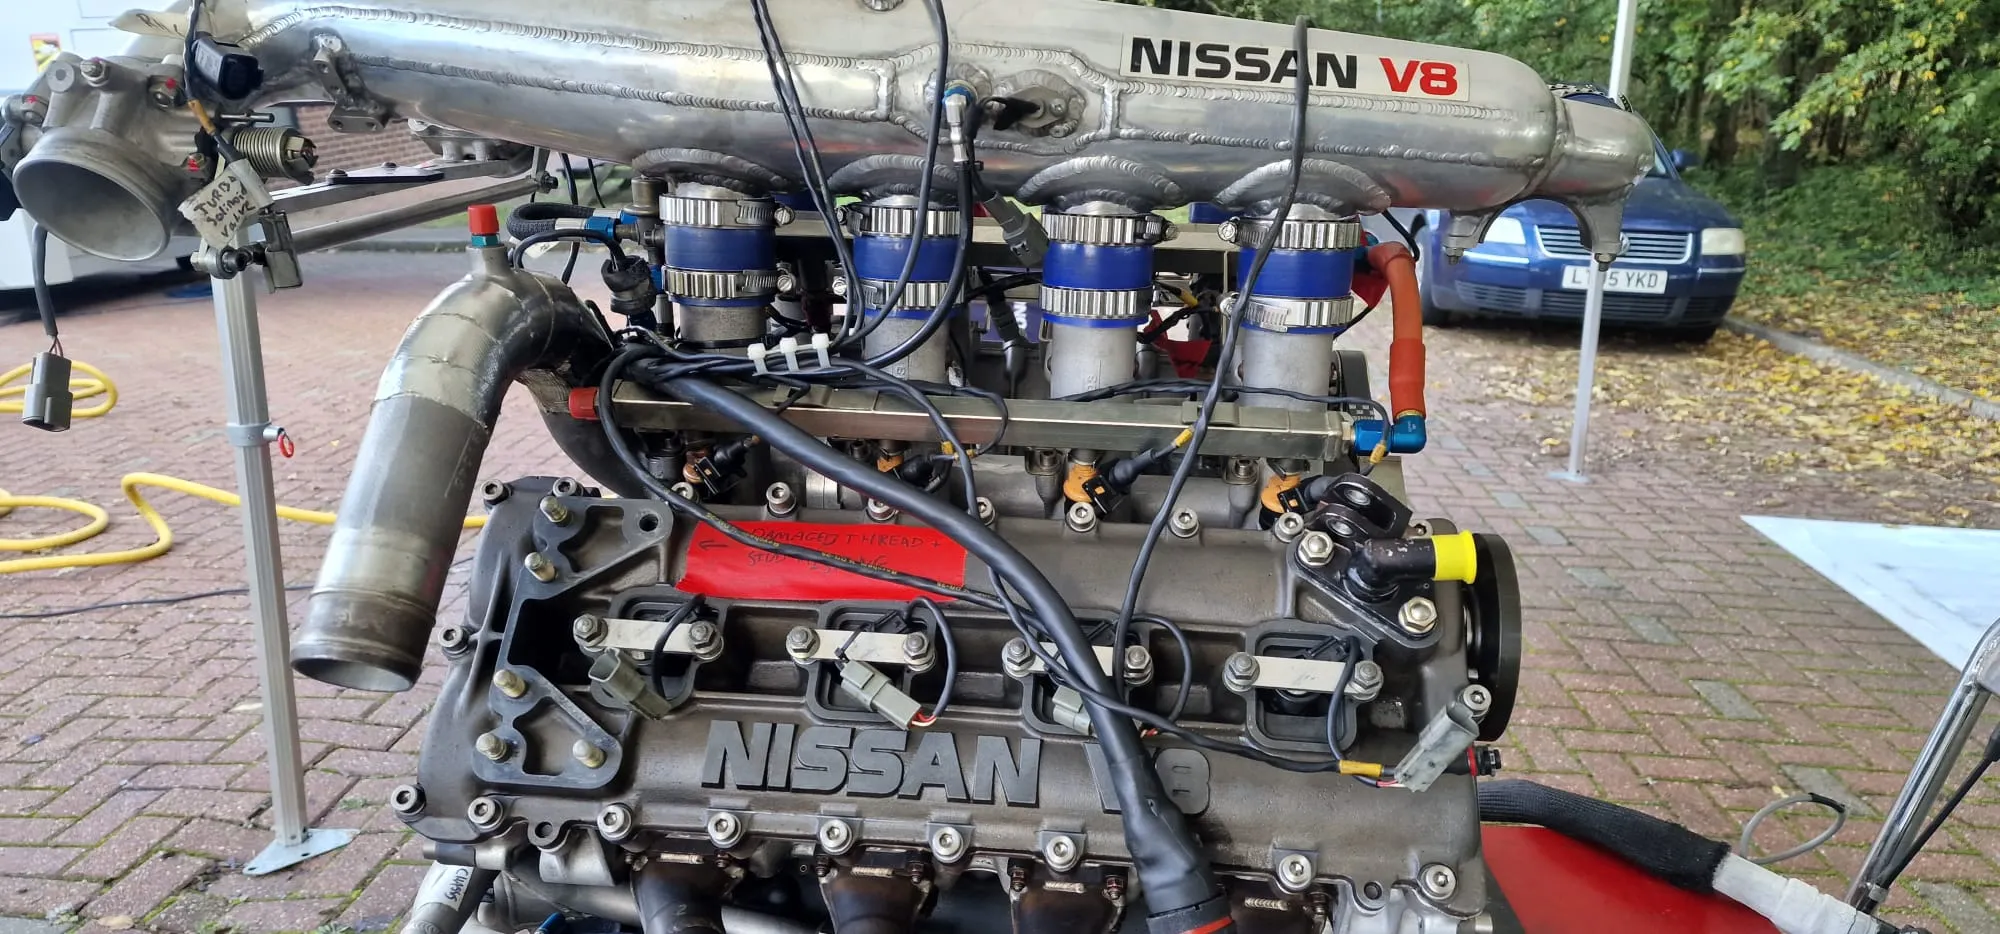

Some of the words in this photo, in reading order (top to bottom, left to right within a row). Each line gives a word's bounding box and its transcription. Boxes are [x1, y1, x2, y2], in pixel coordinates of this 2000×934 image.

[1130, 37, 1357, 89] NISSAN
[1379, 57, 1458, 96] V8
[1626, 271, 1659, 289] YKD
[846, 531, 924, 548] THREAD
[702, 720, 1041, 809] NISSAN
